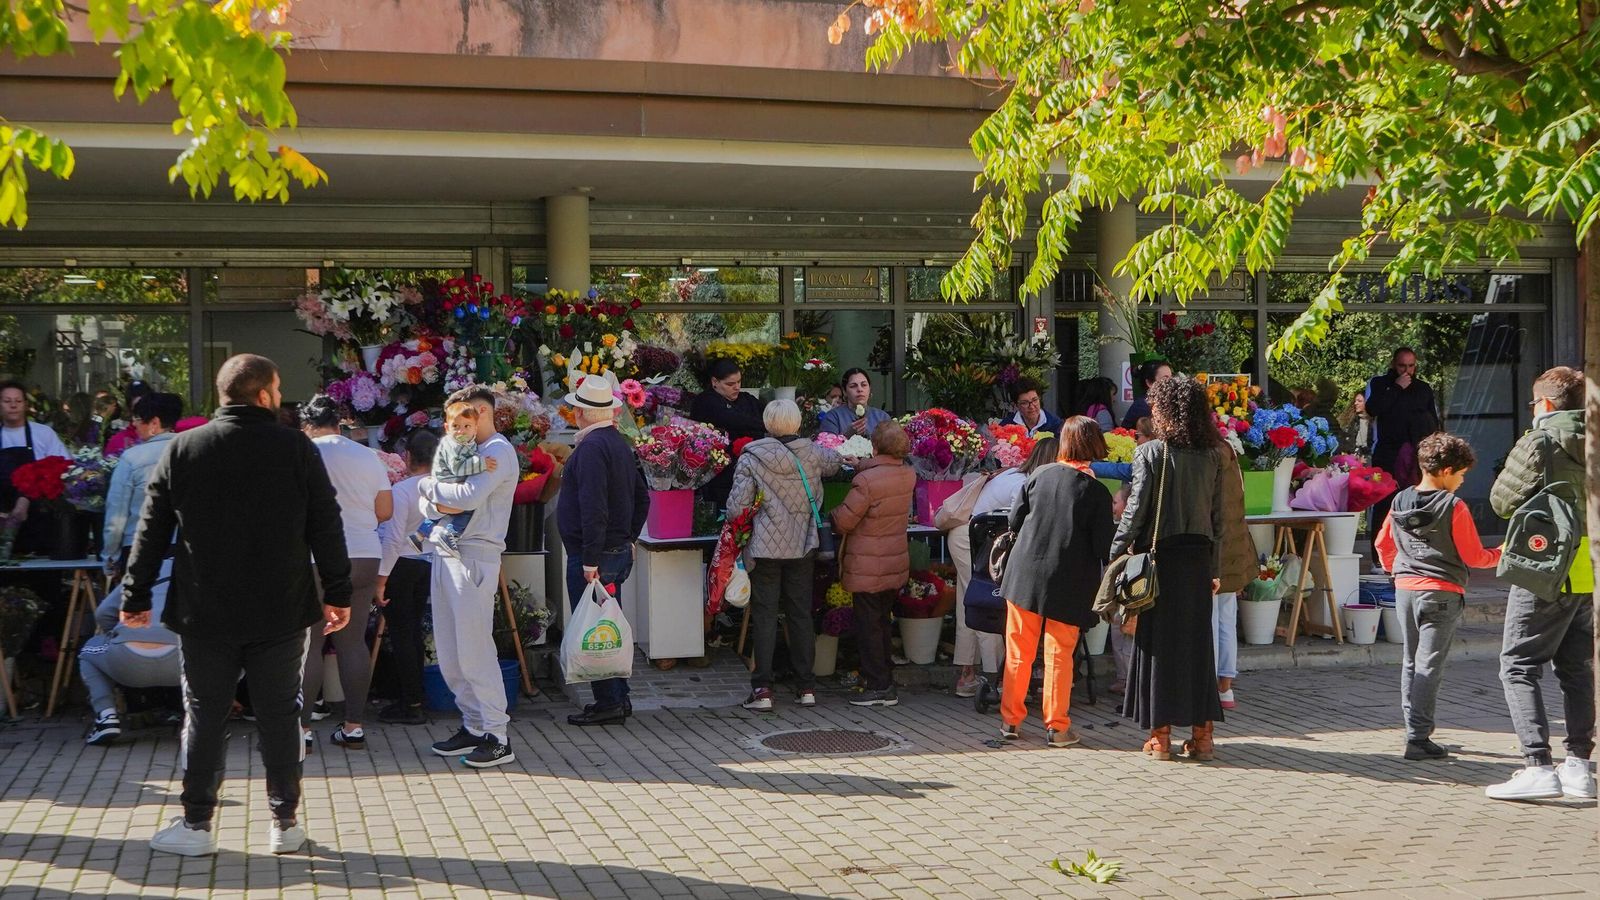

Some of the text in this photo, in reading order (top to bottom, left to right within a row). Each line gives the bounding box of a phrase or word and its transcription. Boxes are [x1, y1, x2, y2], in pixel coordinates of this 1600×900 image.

[809, 268, 874, 286] LOCAL 4
[1232, 271, 1242, 288] 5
